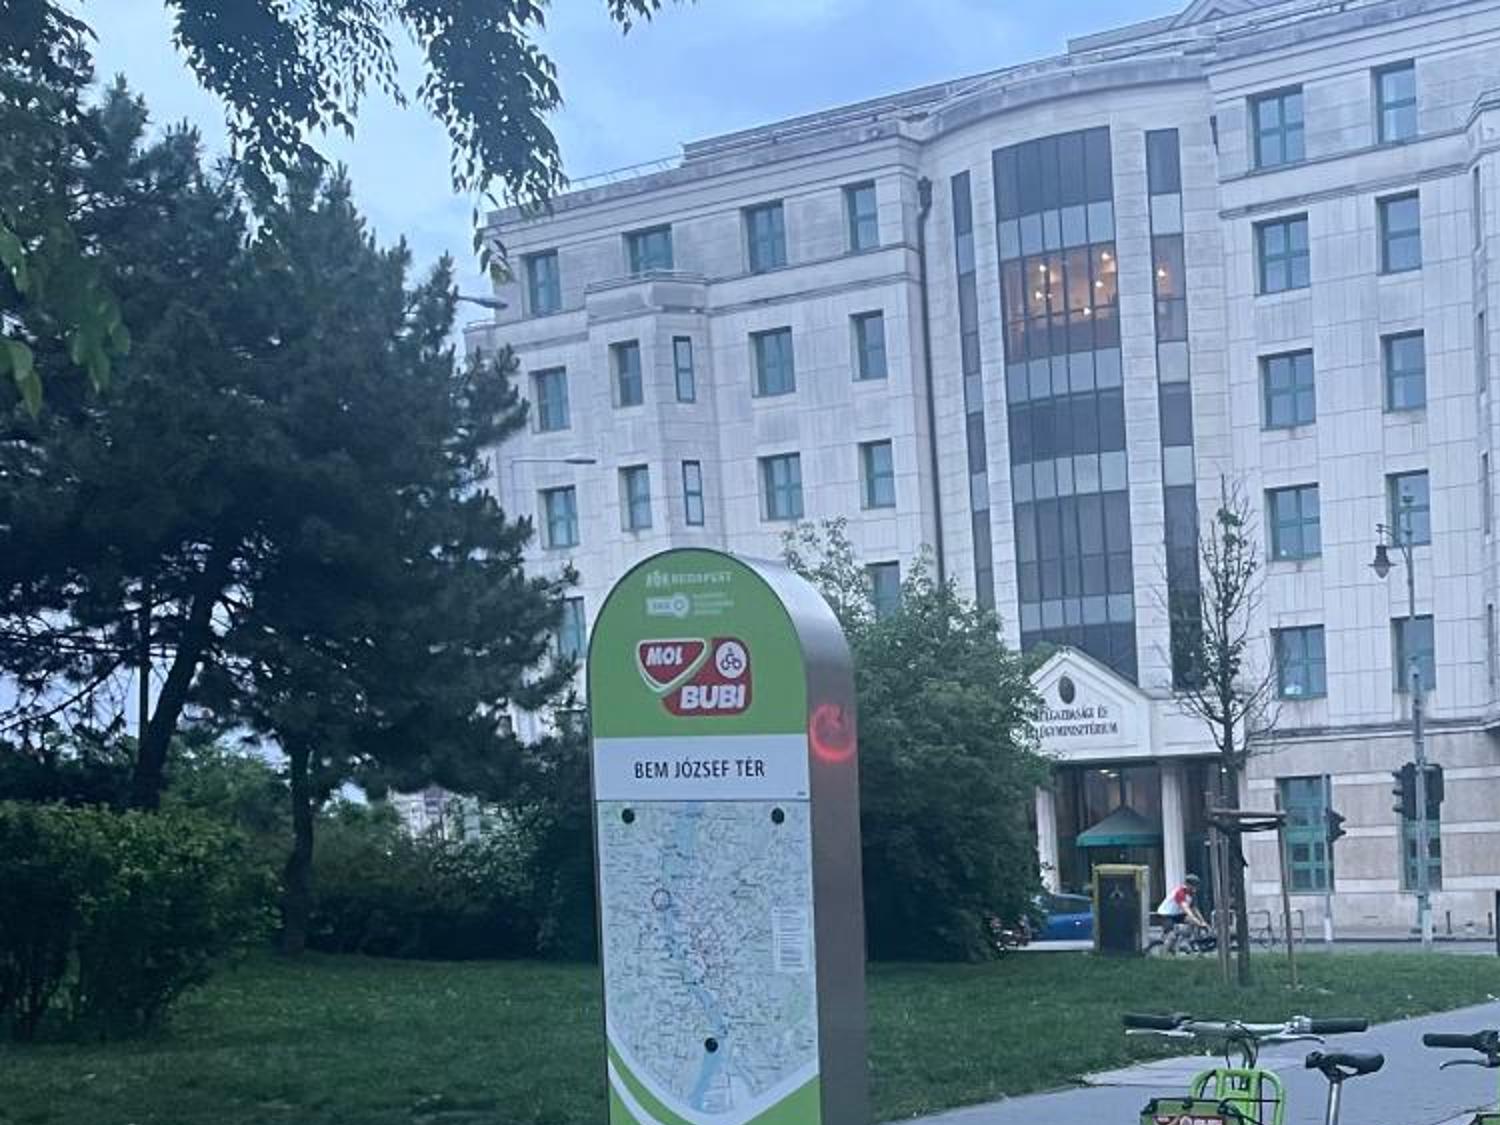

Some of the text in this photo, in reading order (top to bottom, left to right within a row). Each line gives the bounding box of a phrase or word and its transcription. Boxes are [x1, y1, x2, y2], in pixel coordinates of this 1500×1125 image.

[646, 646, 682, 666] MOL
[681, 684, 746, 709] BUBI
[634, 755, 766, 779] BEM JÓZSEF TÉR
